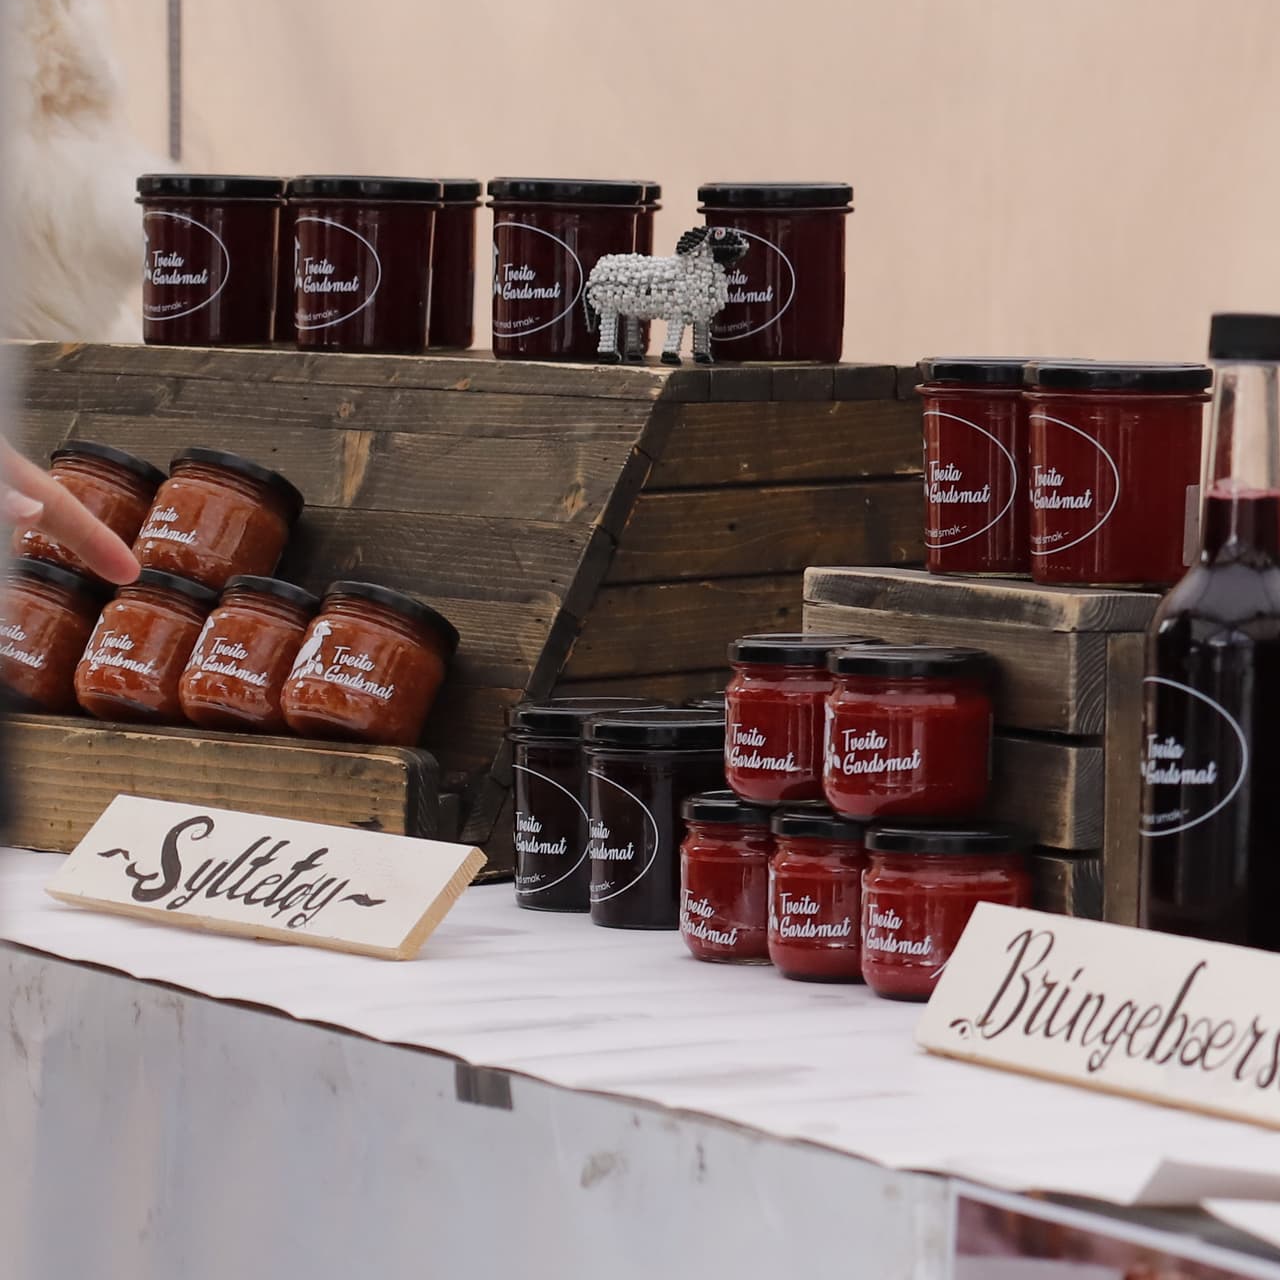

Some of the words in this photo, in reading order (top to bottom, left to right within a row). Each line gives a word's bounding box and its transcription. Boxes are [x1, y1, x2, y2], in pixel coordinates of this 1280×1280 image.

[152, 250, 184, 268] Tveita
[303, 257, 335, 275] Tveita
[152, 268, 208, 285] Gardsmat
[503, 263, 535, 281] Tveita
[303, 275, 359, 293] Gardsmat
[503, 282, 560, 300] Gardsmat
[929, 461, 962, 482] Tveita
[1033, 465, 1064, 487] Tveita
[930, 484, 990, 504] Gardsmat
[1033, 489, 1092, 509] Gardsmat
[100, 630, 135, 651] Tveita
[211, 637, 248, 660] Tveita
[333, 646, 375, 672] Tveita
[202, 656, 268, 686] Gardsmat
[324, 666, 394, 700] Gardsmat
[731, 724, 766, 747] Tveita
[841, 729, 887, 752] Tveita
[729, 748, 794, 771] Gardsmat
[843, 749, 920, 775] Gardsmat
[516, 812, 542, 833] Tveita
[515, 834, 567, 855] Gardsmat
[125, 815, 349, 928] Syltetøy
[684, 889, 715, 919] Tveita
[780, 893, 820, 915] Tveita
[780, 916, 851, 938] Gardsmat
[868, 904, 902, 929] Tveita
[681, 913, 737, 945] Gardsmat
[867, 928, 932, 956] Gardsmat
